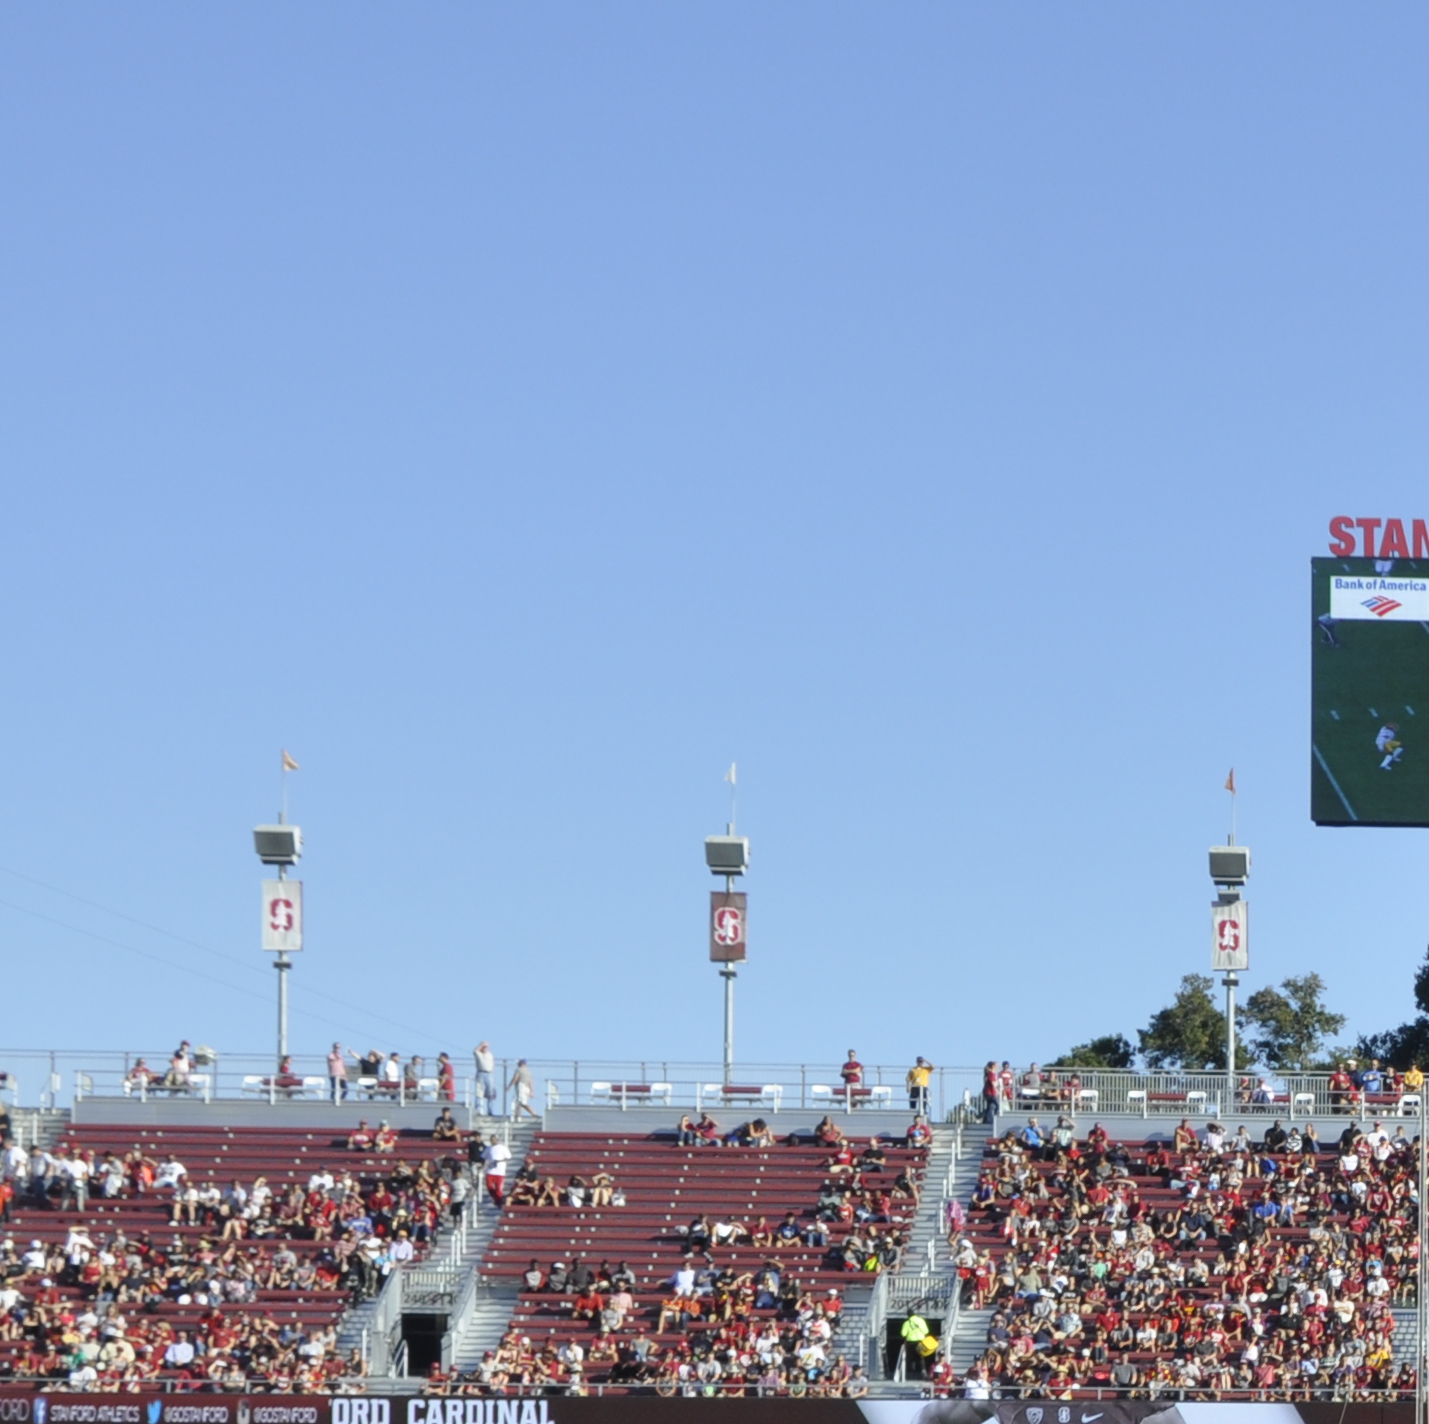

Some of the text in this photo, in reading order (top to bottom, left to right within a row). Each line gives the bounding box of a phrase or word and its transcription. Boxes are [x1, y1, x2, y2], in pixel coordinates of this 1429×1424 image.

[1334, 577, 1427, 592] Bank of America
[0, 1398, 30, 1422] ORD
[49, 1405, 140, 1423] STANFORD ATHLETICS
[164, 1406, 229, 1424] @GOSTANFORD
[253, 1406, 317, 1424] @GOSTANFORD
